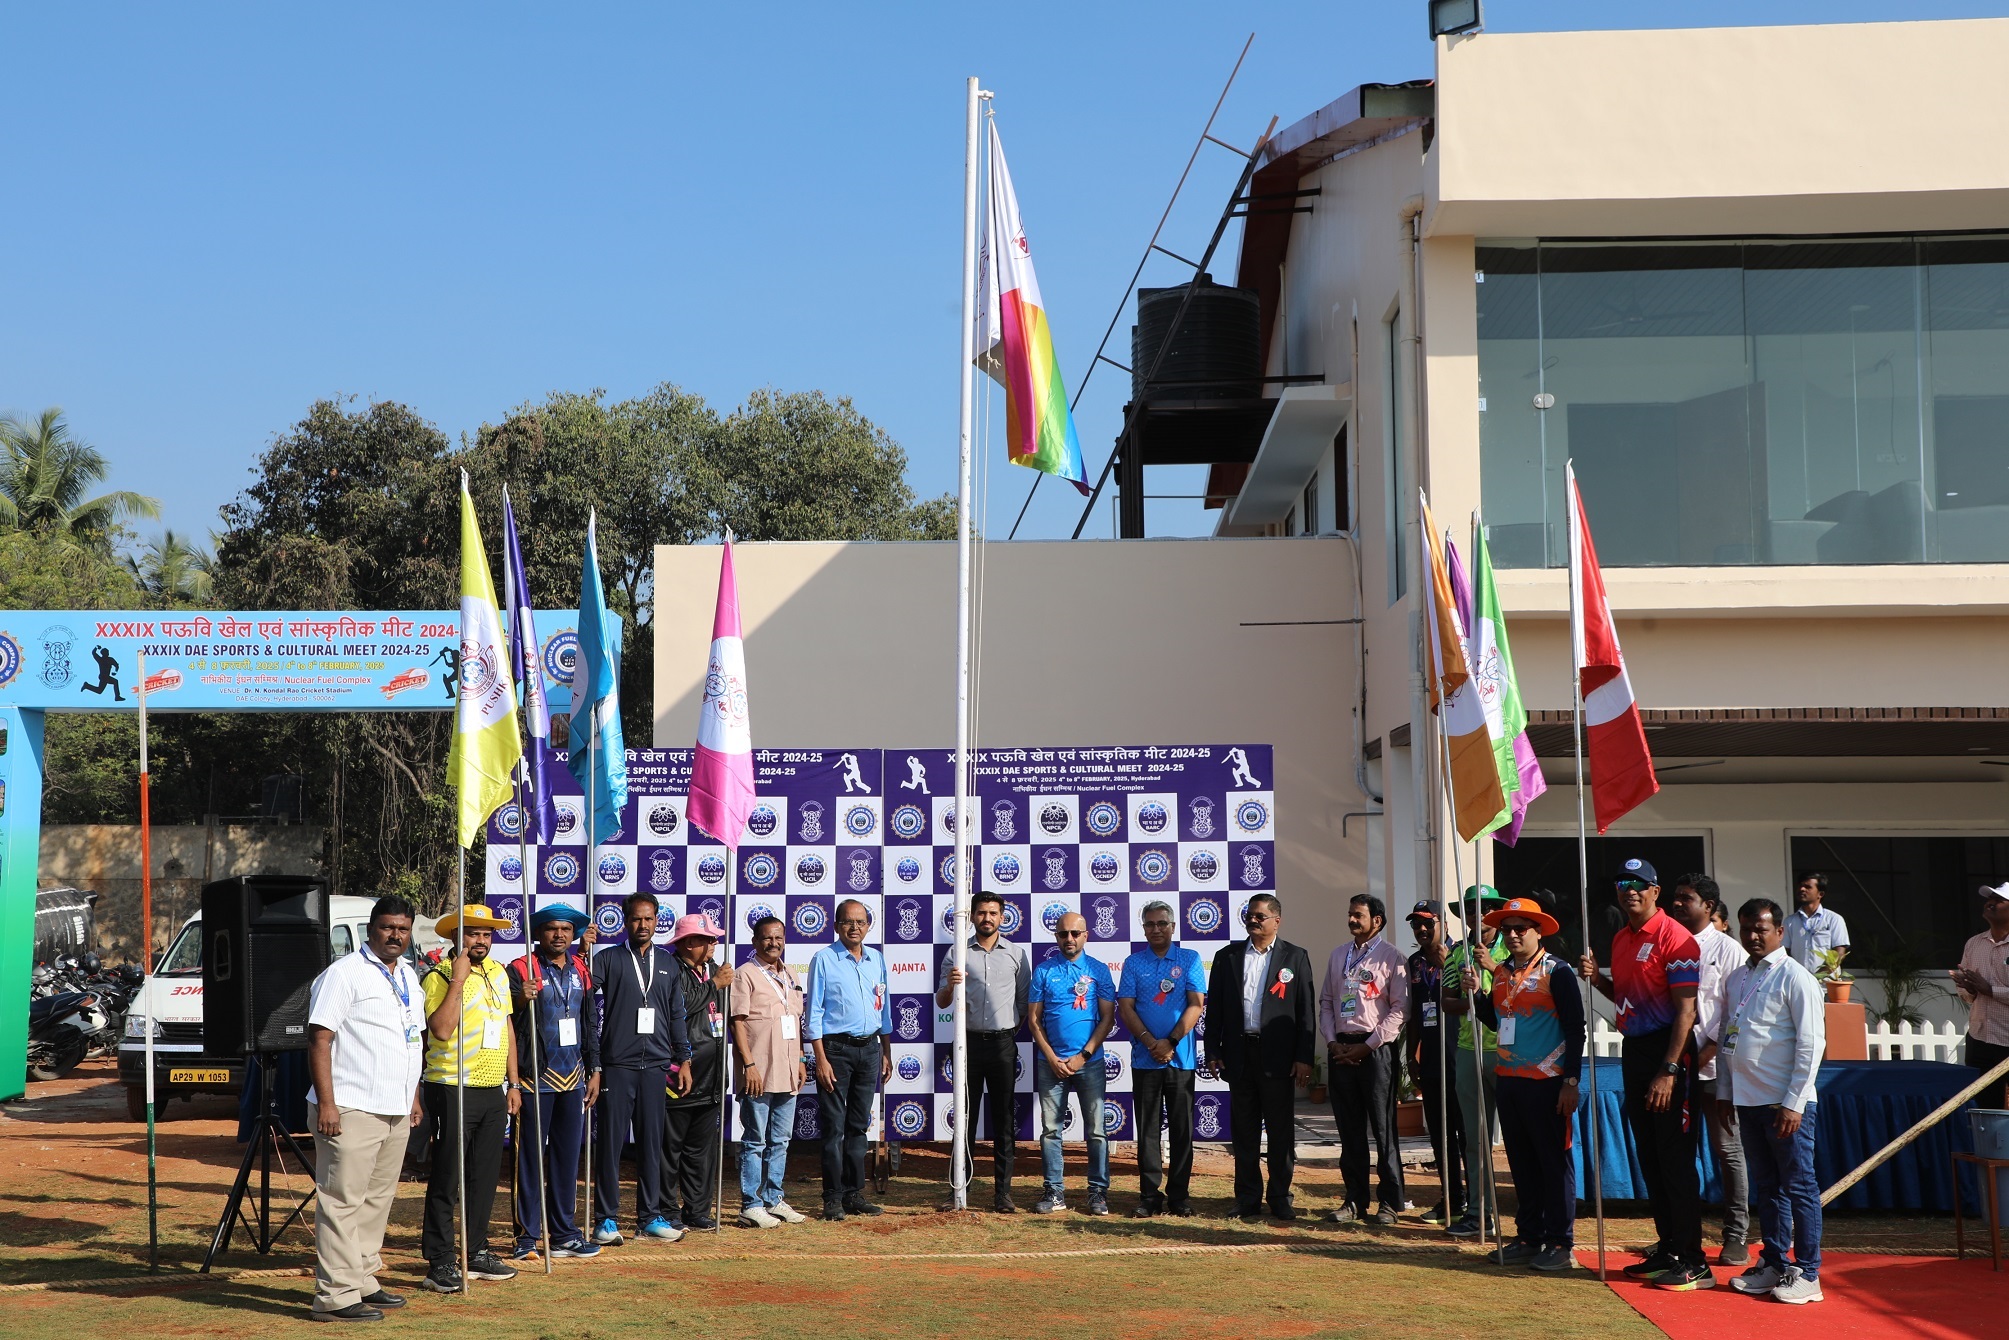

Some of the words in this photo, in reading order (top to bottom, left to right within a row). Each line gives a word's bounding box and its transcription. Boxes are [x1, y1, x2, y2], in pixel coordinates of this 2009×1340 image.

[95, 622, 155, 638] XXXIX
[160, 616, 213, 638] पऊवि
[218, 616, 252, 638] खेल
[258, 618, 284, 640] एवं
[288, 616, 376, 642] सांस्कृतिक
[381, 616, 414, 638] मीट
[420, 624, 459, 638] 2024-
[1, 640, 16, 669] COMPLEX
[143, 644, 181, 656] XXXIX
[185, 644, 208, 656] DAE
[213, 644, 260, 656] SPORTS
[264, 644, 273, 656] &
[277, 644, 339, 656] CULTURAL
[344, 644, 377, 656] MEET
[381, 644, 429, 656] 2024-25
[548, 640, 561, 667] NUCLEAR
[188, 661, 195, 670] 4
[197, 658, 206, 670] से
[211, 662, 218, 670] 8
[255, 661, 279, 670] 2025
[297, 661, 306, 670] to
[319, 661, 363, 671] FEBRUARY,
[365, 661, 385, 670] 2025
[145, 676, 180, 689] CRICKET
[201, 673, 232, 684] नाभिकीय
[284, 676, 315, 684] Nuclear
[317, 676, 334, 684] Fuel
[336, 676, 371, 685] Complex
[390, 676, 427, 689] CRICKET
[481, 676, 509, 716] PUSHK
[624, 749, 638, 762] वि
[640, 749, 666, 762] खेल
[669, 749, 688, 764] एवं
[755, 749, 780, 763] मीट
[782, 752, 823, 763] 2024-25
[990, 748, 1027, 762] पऊवि
[1030, 748, 1055, 762] खेल
[1057, 748, 1076, 763] एवं
[1079, 746, 1141, 763] सांस्कृतिक
[1143, 746, 1168, 760] मीट
[1170, 747, 1211, 759] 2024-25
[632, 766, 668, 775] SPORTS
[670, 766, 678, 775] &
[759, 767, 796, 776] 2024-25
[1002, 766, 1021, 775] DAE
[1022, 765, 1057, 774] SPORTS
[1060, 765, 1067, 774] &
[1069, 764, 1115, 773] CULTURAL
[1117, 764, 1143, 773] MEET
[1147, 763, 1185, 772] 2024-25
[1117, 784, 1145, 792] Complex
[891, 963, 927, 975] AJANTA
[172, 1072, 194, 1082] AP29
[197, 1073, 205, 1081] W
[208, 1072, 227, 1081] 1053
